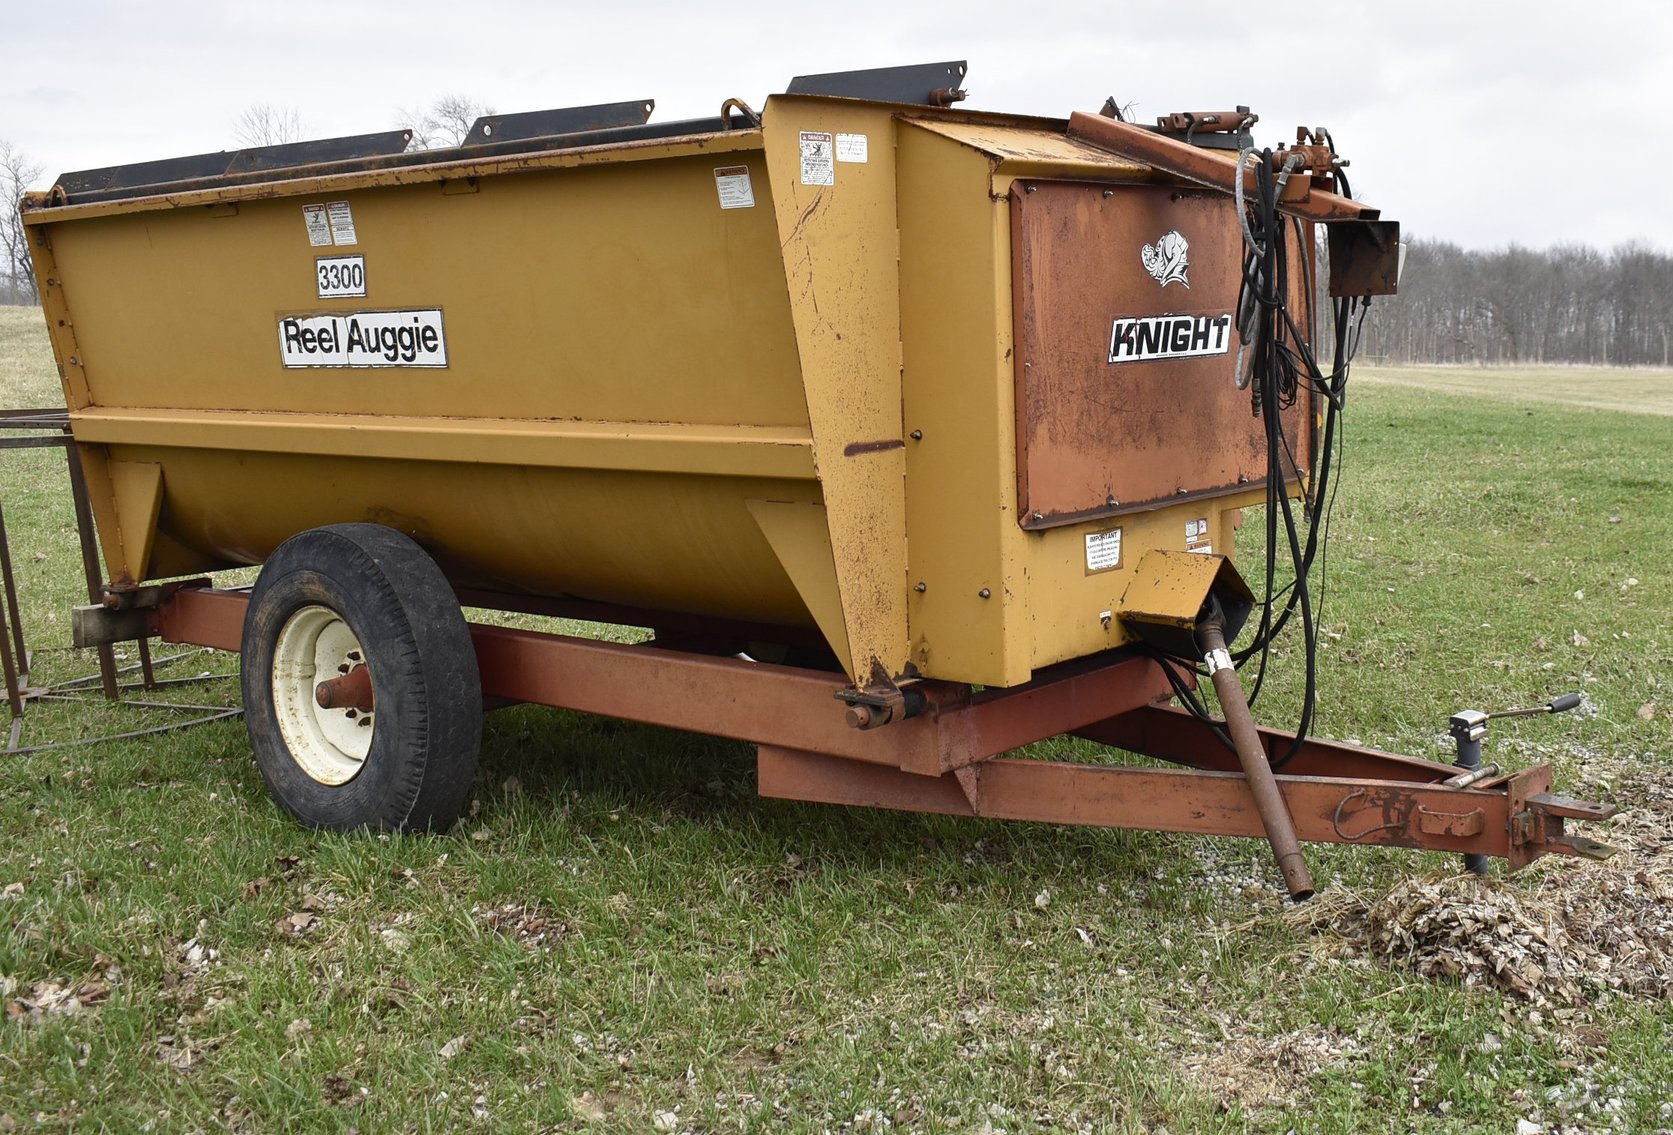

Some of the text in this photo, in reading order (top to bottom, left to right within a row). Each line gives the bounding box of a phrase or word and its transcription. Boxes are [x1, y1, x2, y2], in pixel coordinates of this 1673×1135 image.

[319, 263, 363, 290] 3300
[283, 316, 439, 362] Reel Auggie
[1113, 318, 1229, 356] KNIGHT
[1089, 532, 1118, 542] IMPORTANT
